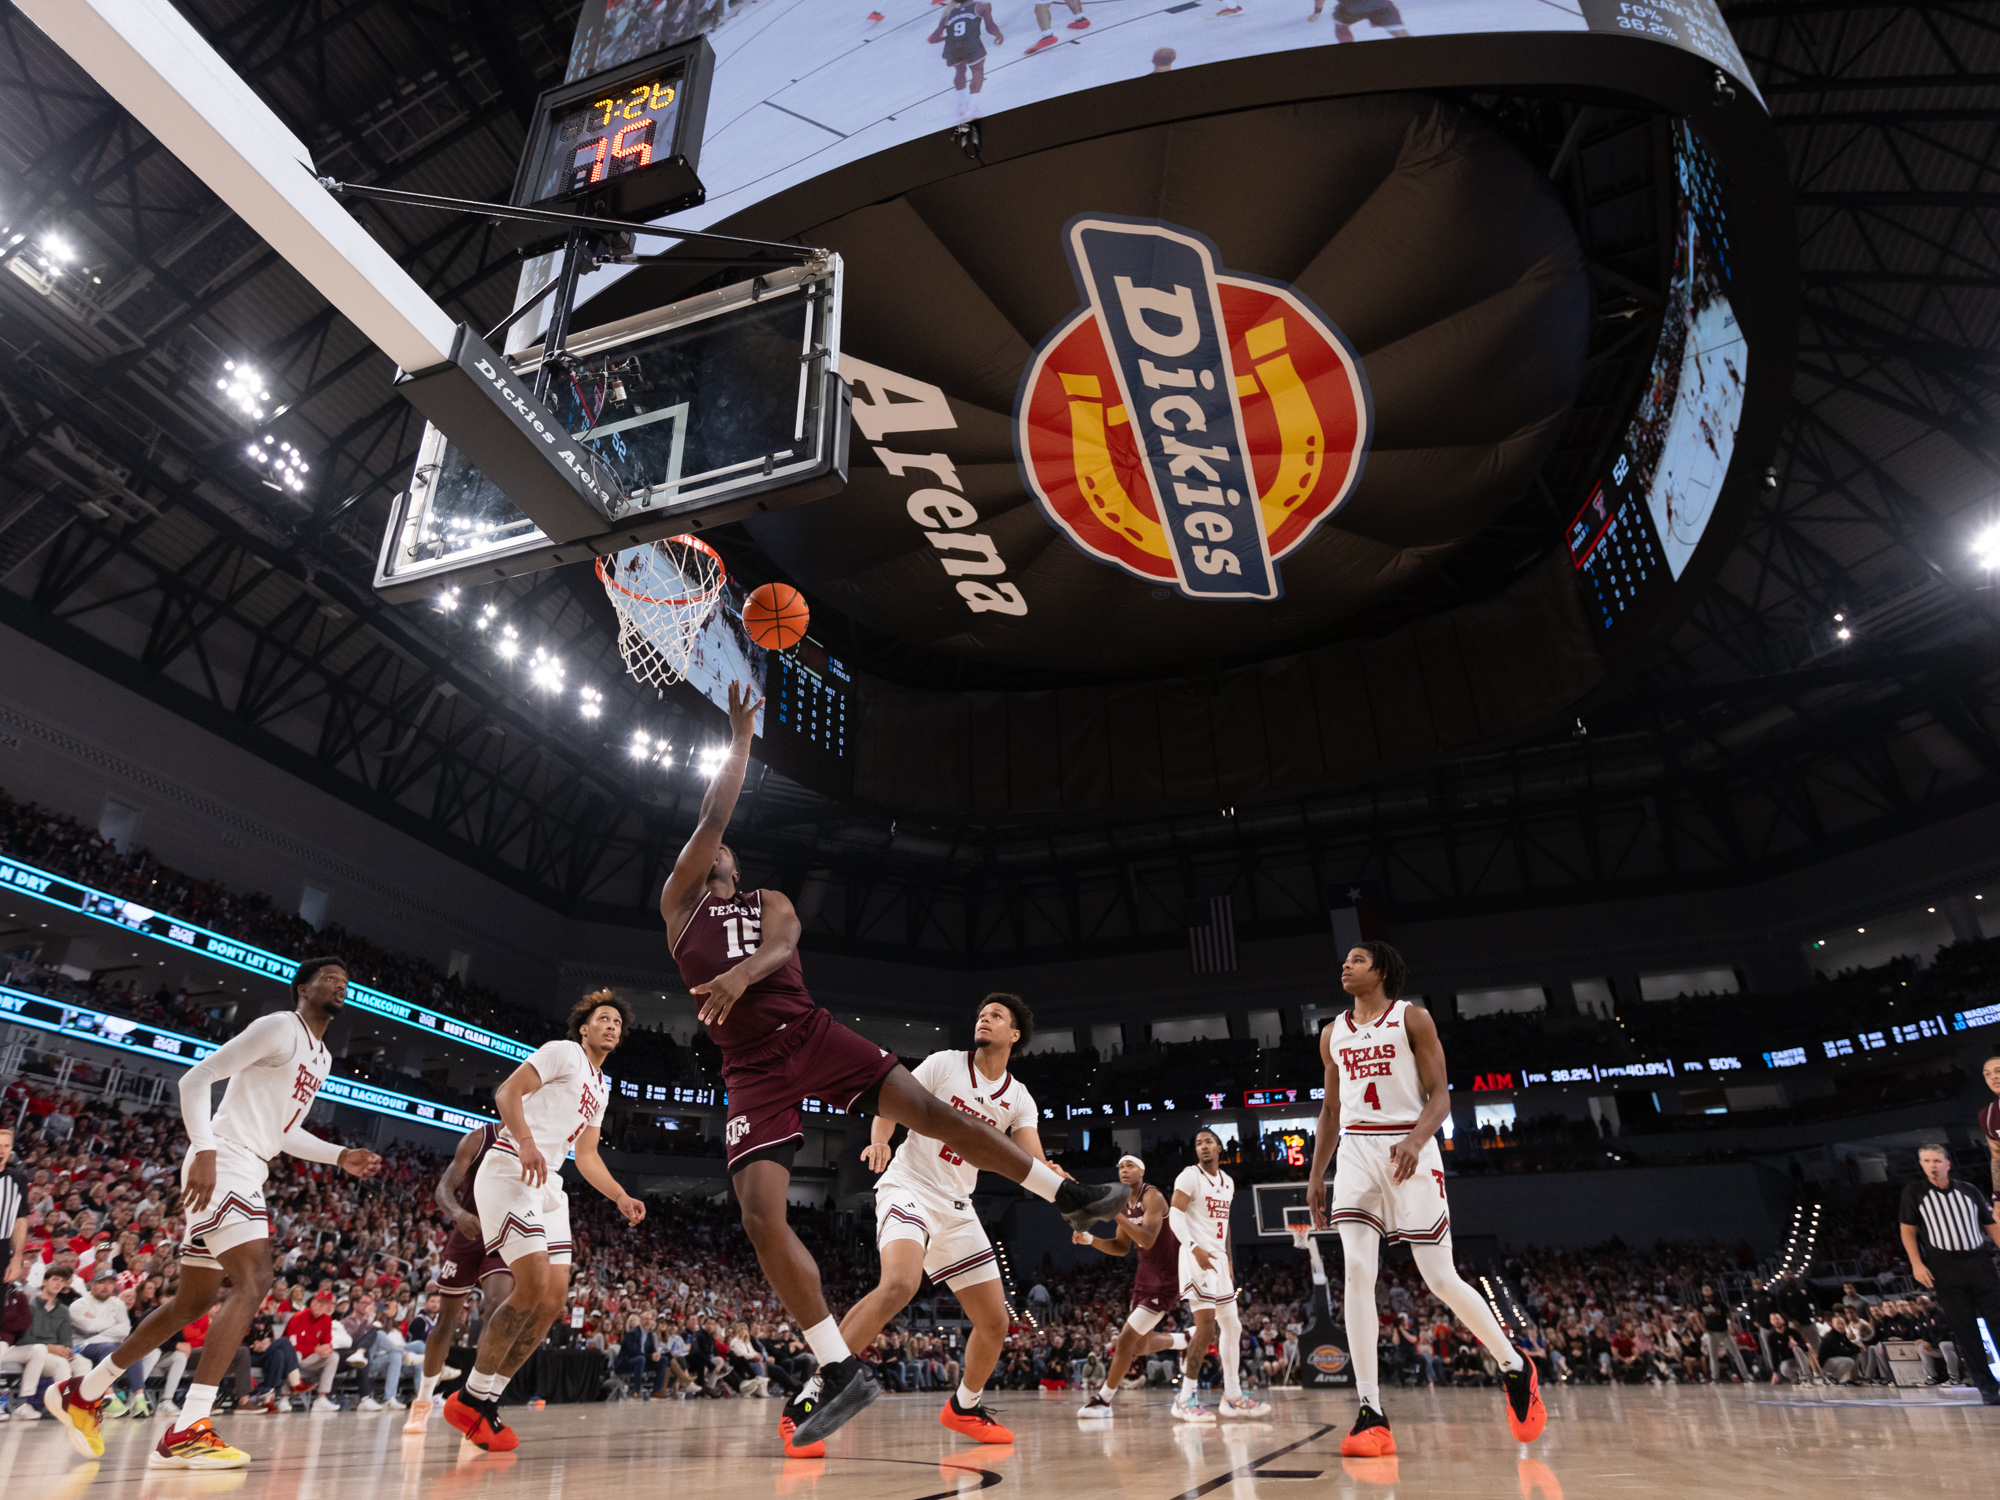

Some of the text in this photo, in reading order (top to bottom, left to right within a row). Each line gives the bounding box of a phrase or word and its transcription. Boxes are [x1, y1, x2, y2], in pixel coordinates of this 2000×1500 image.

[1620, 3, 1663, 22] FG%
[953, 21, 966, 37] 9
[1616, 16, 1679, 40] 36.2%
[594, 83, 675, 126] 7:26
[473, 358, 556, 444] Dickies
[1114, 276, 1242, 576] Dickies
[1612, 454, 1630, 486] 52
[840, 351, 1028, 617] Arena
[833, 667, 851, 682] FOULS
[834, 658, 844, 670] TOL
[779, 655, 793, 669] PLYR
[796, 667, 808, 679] PTS
[811, 676, 822, 688] REB
[825, 686, 836, 697] AST
[783, 666, 788, 674] 0
[827, 695, 832, 703] 2
[783, 677, 787, 685] 1
[797, 687, 805, 697] 10
[813, 697, 817, 705] 1
[826, 706, 831, 714] 2
[779, 713, 787, 723] 15
[796, 724, 801, 733] 2
[811, 733, 816, 741] 4
[780, 701, 787, 712] 10
[797, 713, 802, 721] 0
[811, 722, 816, 730] 0
[14, 870, 53, 893] DRY
[708, 904, 749, 917] TEXAS
[722, 917, 761, 958] 15
[207, 938, 246, 962] DON'T
[245, 950, 267, 969] LET
[266, 960, 281, 973] TP
[355, 989, 412, 1019] BACKCOURT
[1954, 1002, 2000, 1022] 9 WASHIN
[1952, 1020, 1967, 1031] 10
[443, 1021, 466, 1039] BEST
[464, 1028, 490, 1047] CLEAN
[490, 1037, 516, 1055] PANTS
[1770, 1047, 1805, 1059] CARTER
[1919, 1020, 1929, 1029] 0
[1773, 1055, 1807, 1068] PHELPS
[1922, 1028, 1932, 1037] 0
[1338, 1043, 1396, 1066] TEXAS
[1346, 1062, 1393, 1081] TECH
[1551, 1067, 1592, 1083] 36.2%
[1625, 1062, 1668, 1077] 40.9%
[1708, 1057, 1742, 1071] 50%
[320, 1080, 351, 1097] YOUR
[351, 1087, 409, 1111] BACKCOURT
[620, 1080, 627, 1088] 17
[647, 1084, 653, 1092] 5
[674, 1087, 681, 1095] 0
[626, 1090, 638, 1098] PTS
[674, 1094, 680, 1102] 4
[1309, 1088, 1325, 1100] 52
[1363, 1082, 1381, 1110] 4
[802, 1097, 808, 1105] 2
[1043, 1099, 1175, 1119] % 3 PT% % FT% %
[283, 1108, 301, 1133] 1
[442, 1111, 465, 1126] BEST
[1287, 1146, 1305, 1166] 15
[1205, 1196, 1230, 1209] TEXAS
[1216, 1222, 1223, 1239] 3
[1314, 1373, 1348, 1383] Arena
